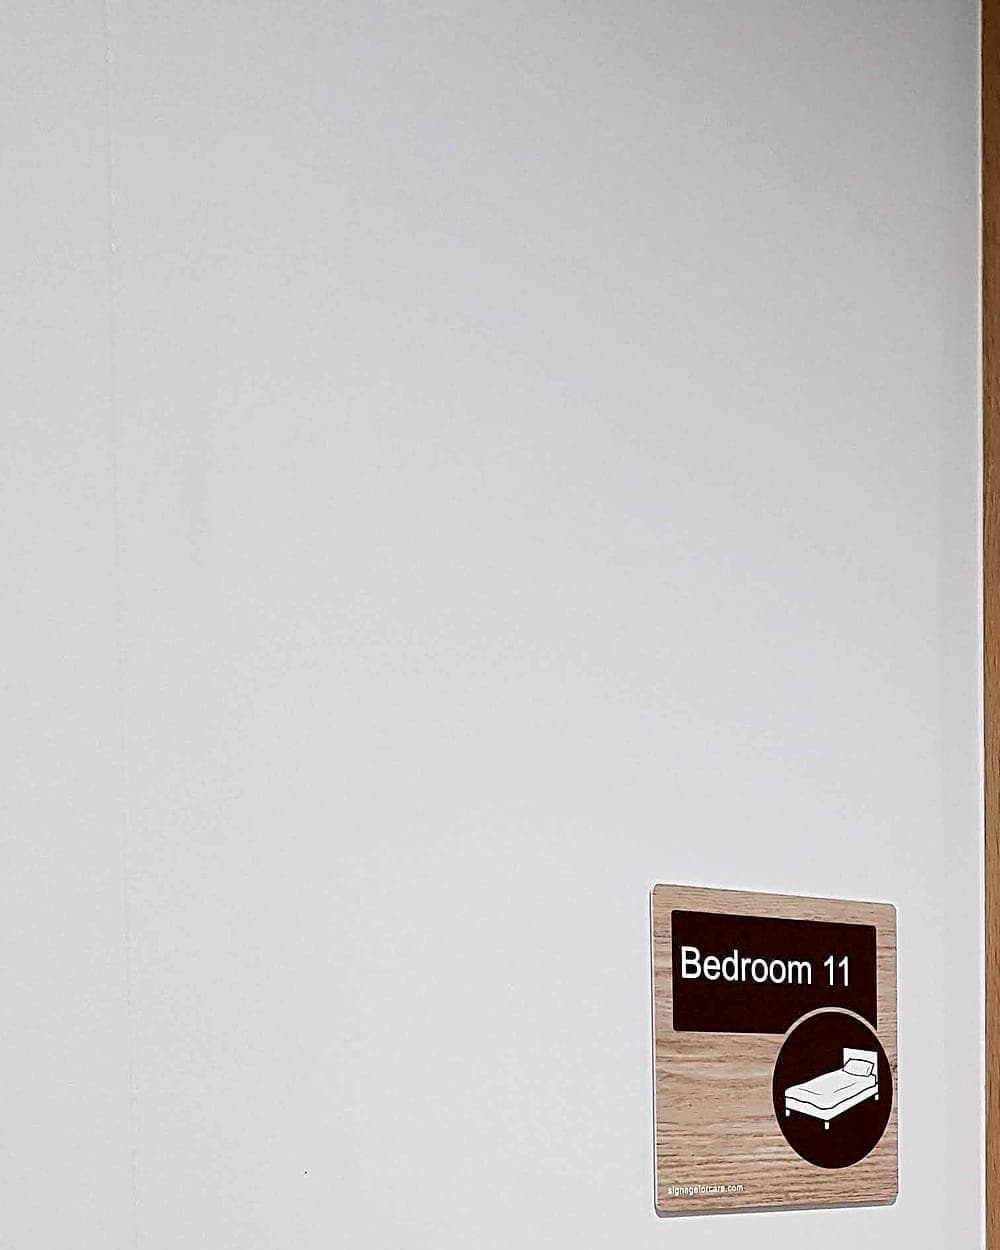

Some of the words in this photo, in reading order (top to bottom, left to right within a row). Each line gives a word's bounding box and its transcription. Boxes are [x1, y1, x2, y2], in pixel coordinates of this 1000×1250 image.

[681, 946, 812, 985] Bedroom
[824, 955, 849, 987] 11
[667, 1184, 744, 1196] signageforcare.com
